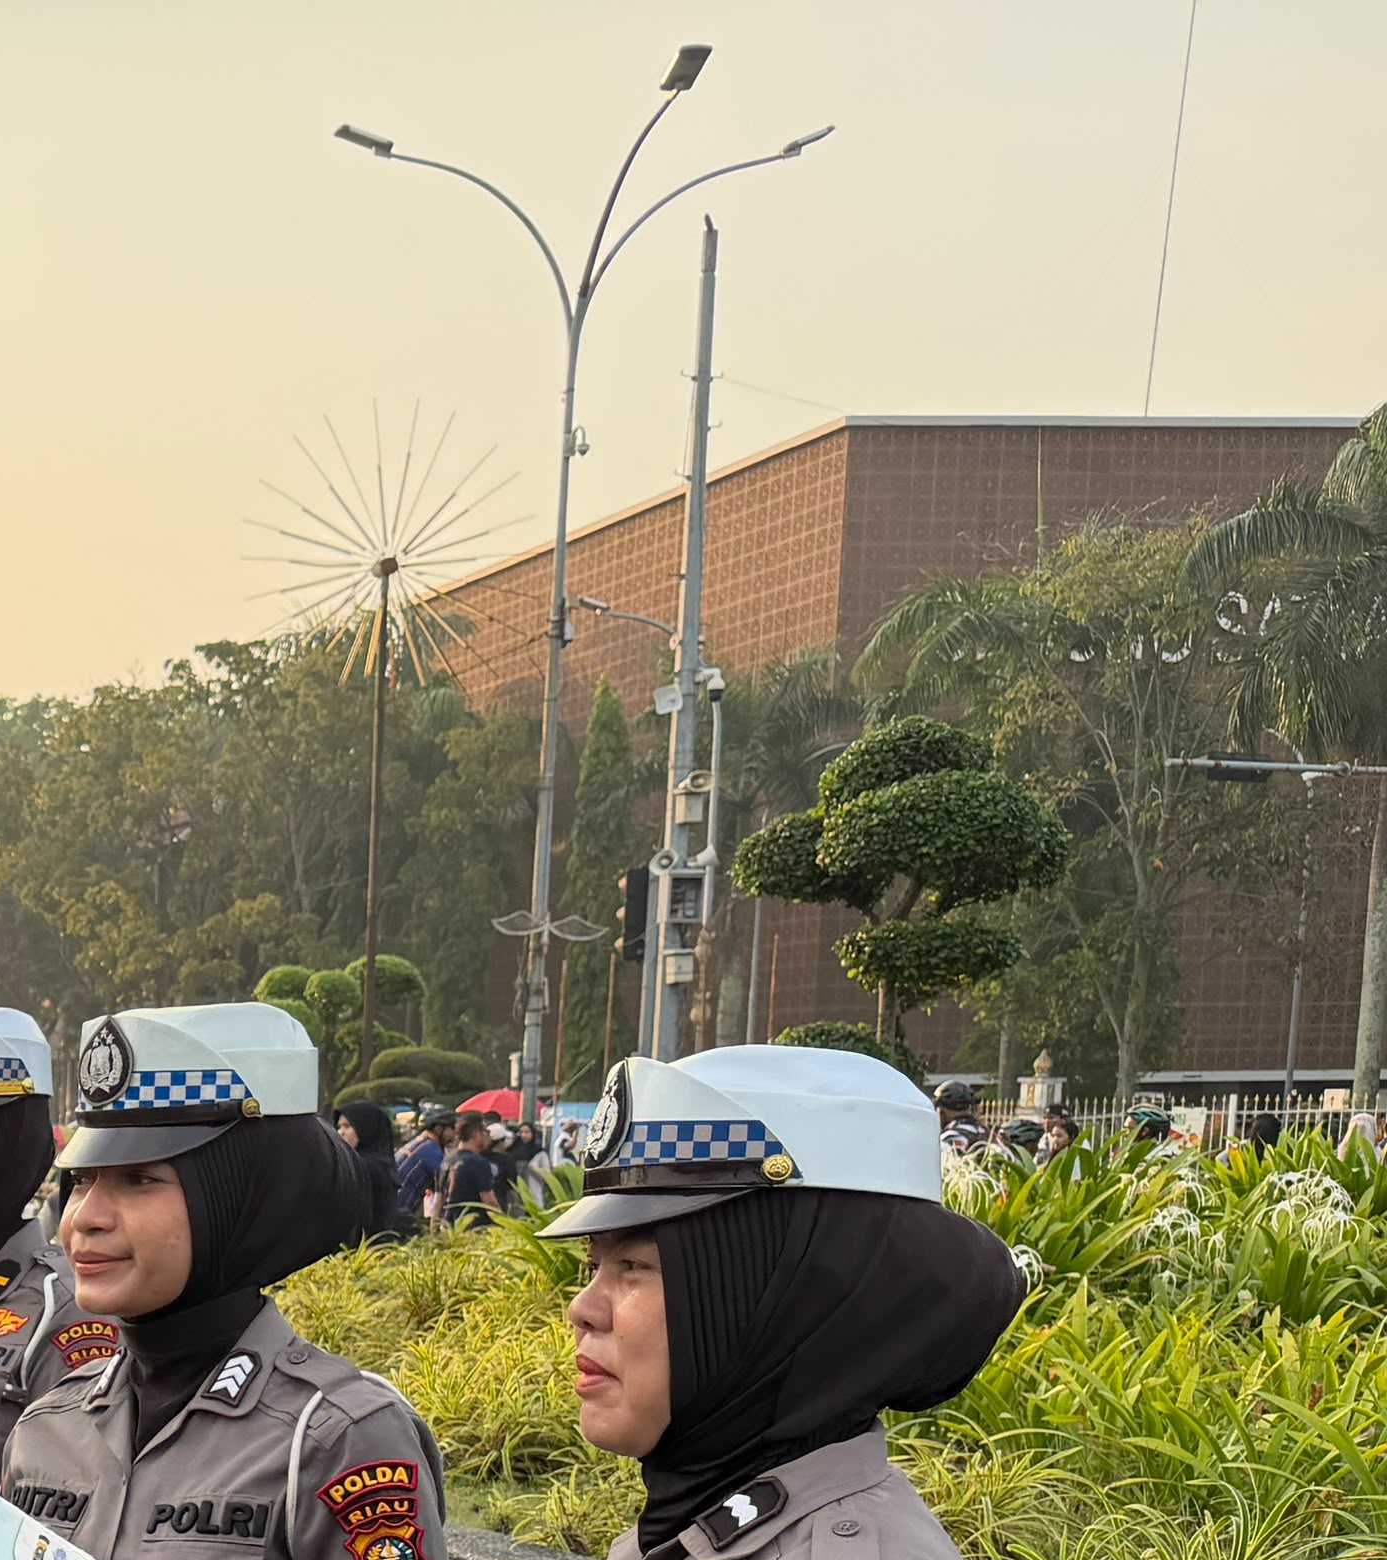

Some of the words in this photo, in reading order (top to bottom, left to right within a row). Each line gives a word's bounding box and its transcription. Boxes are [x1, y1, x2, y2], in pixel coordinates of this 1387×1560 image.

[59, 1324, 114, 1345] POLDA
[70, 1348, 113, 1362] RIAU
[329, 1467, 409, 1503] POLDA
[146, 1501, 268, 1538] POLRI
[348, 1502, 409, 1524] RIAU
